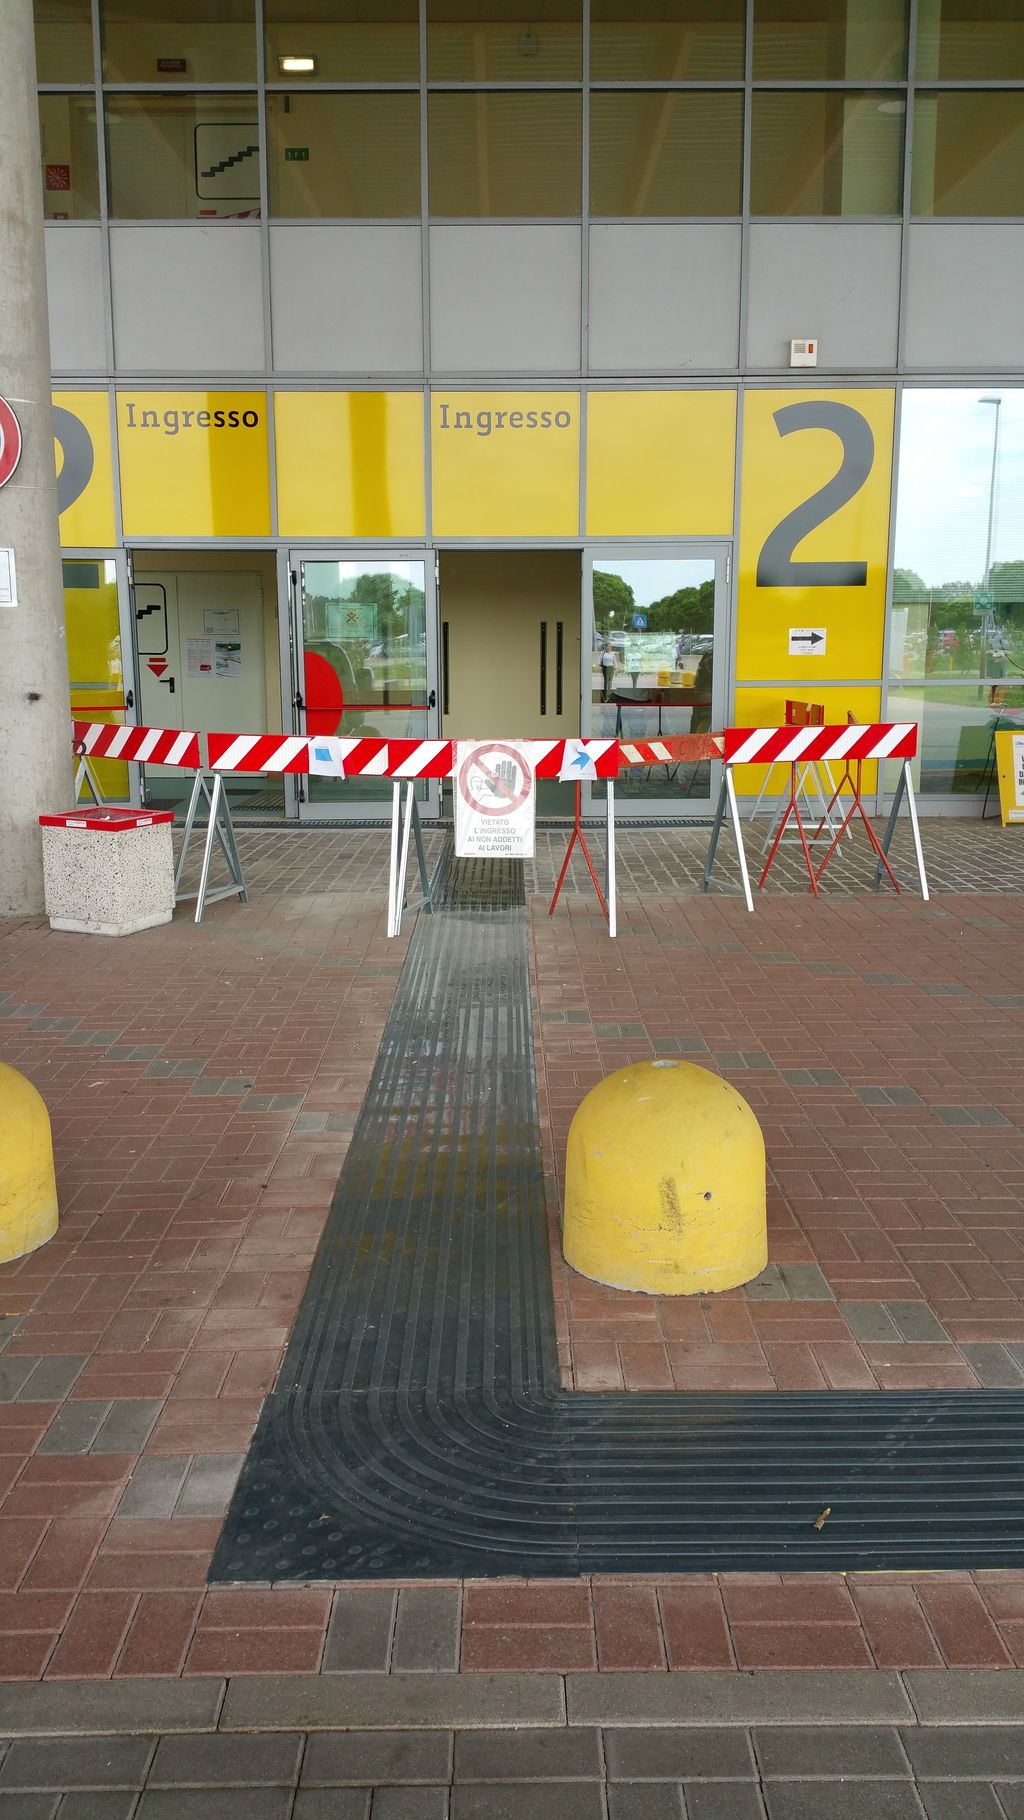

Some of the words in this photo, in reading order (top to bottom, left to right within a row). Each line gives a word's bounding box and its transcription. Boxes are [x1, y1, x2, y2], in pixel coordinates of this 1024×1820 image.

[126, 403, 259, 435] Ingresso
[440, 404, 571, 437] Ingresso
[756, 401, 875, 587] 2
